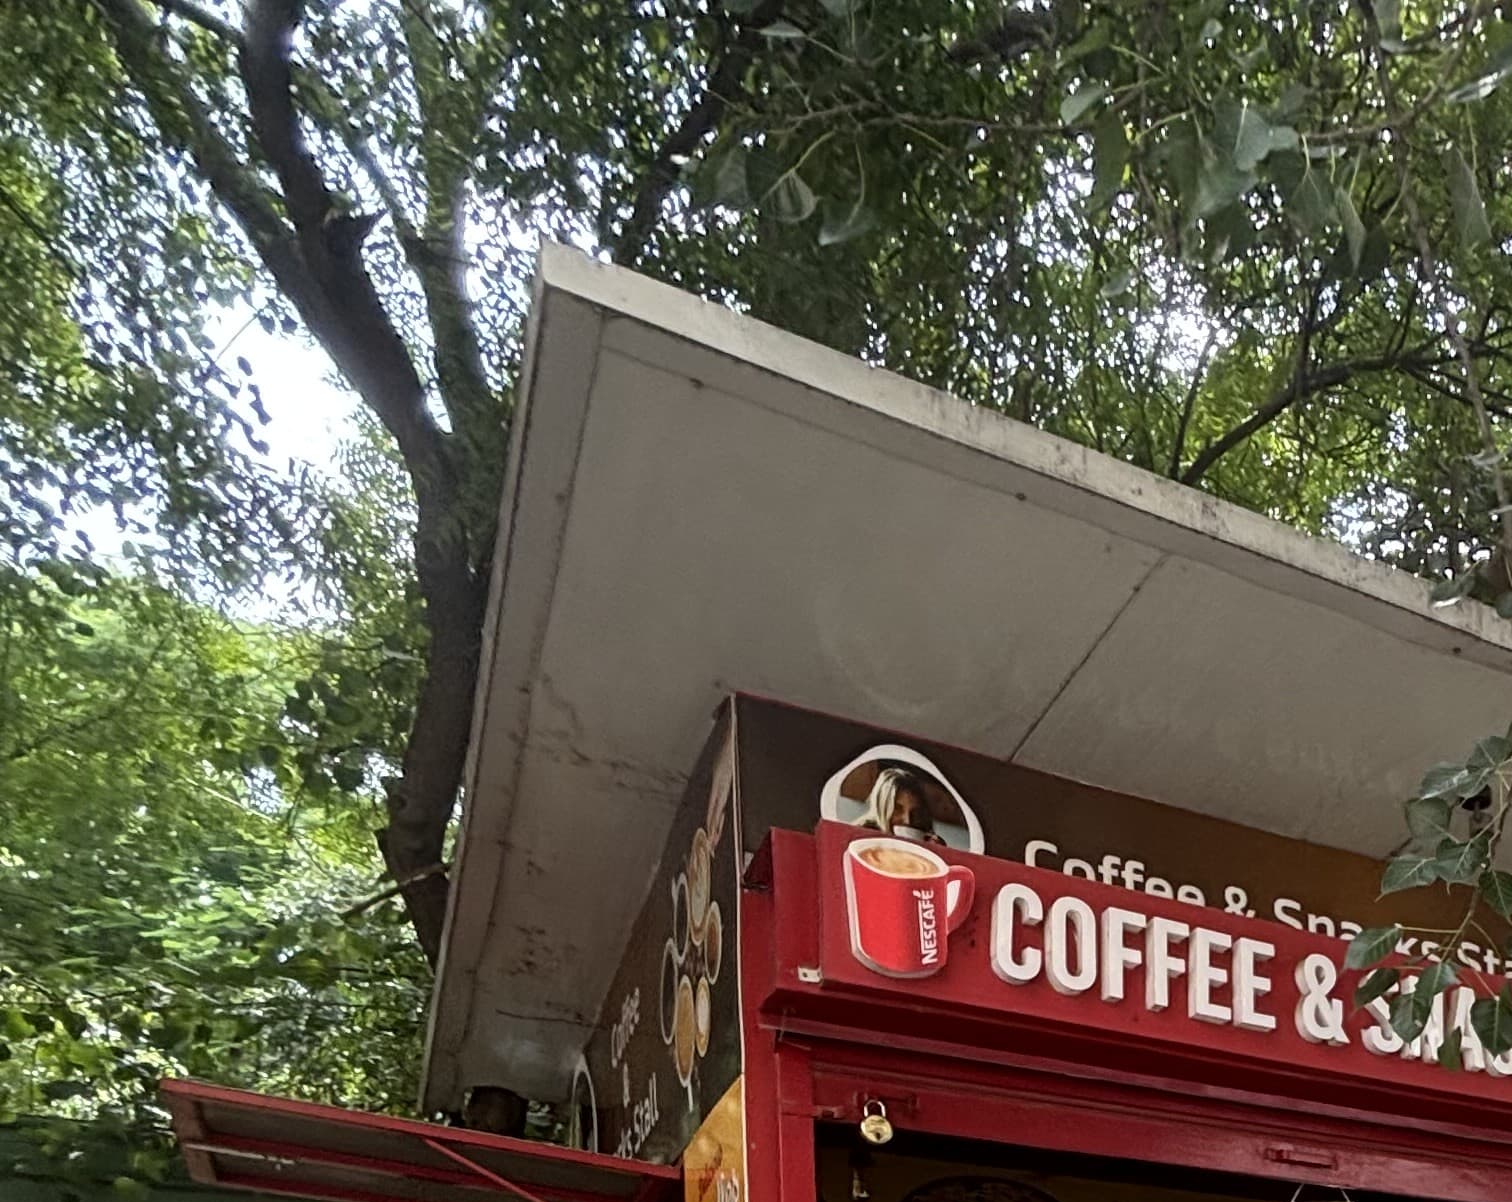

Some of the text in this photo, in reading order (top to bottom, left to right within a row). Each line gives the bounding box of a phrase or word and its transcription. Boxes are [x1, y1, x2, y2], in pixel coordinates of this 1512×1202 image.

[1224, 886, 1255, 918] &
[990, 883, 1277, 1032] COFFEE
[1295, 954, 1349, 1046] &
